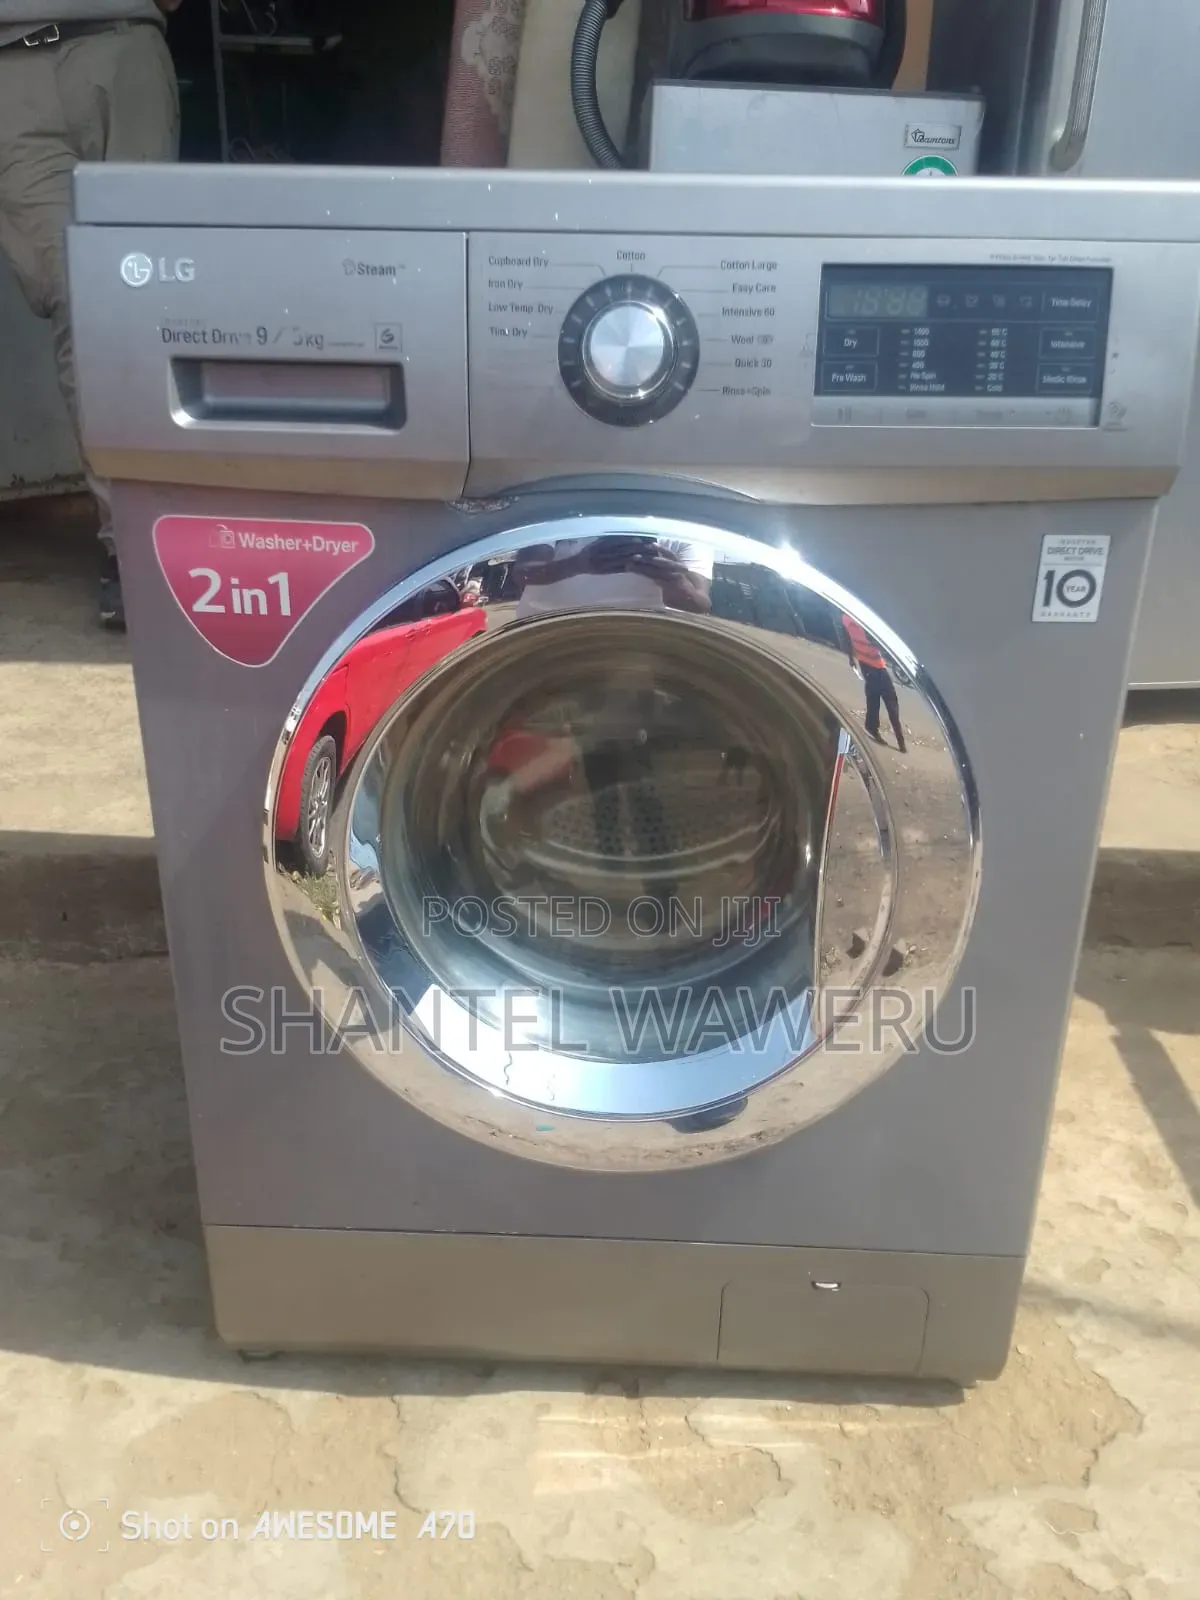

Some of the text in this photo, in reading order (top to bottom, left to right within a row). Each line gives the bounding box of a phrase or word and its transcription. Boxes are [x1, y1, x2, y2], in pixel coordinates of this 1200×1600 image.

[488, 255, 550, 269] Cupboard Dry
[616, 250, 646, 261] Cotton
[158, 257, 196, 282] LG
[356, 262, 397, 277] Steam
[720, 259, 750, 271] Cotton
[488, 279, 524, 291] Iron Dry
[732, 282, 777, 295] Easy Care
[488, 301, 508, 313] Low
[537, 303, 554, 316] Dry
[721, 307, 776, 317] Intensive 60
[160, 326, 208, 345] Direct
[256, 325, 269, 347] 9
[512, 327, 528, 340] Dry
[843, 337, 858, 349] Dry
[734, 358, 773, 368] Quick 30
[831, 372, 867, 383] Pre Wash
[238, 532, 359, 556] Washer+Dryer
[188, 567, 292, 617] 2 in 1
[1043, 568, 1097, 609] 10
